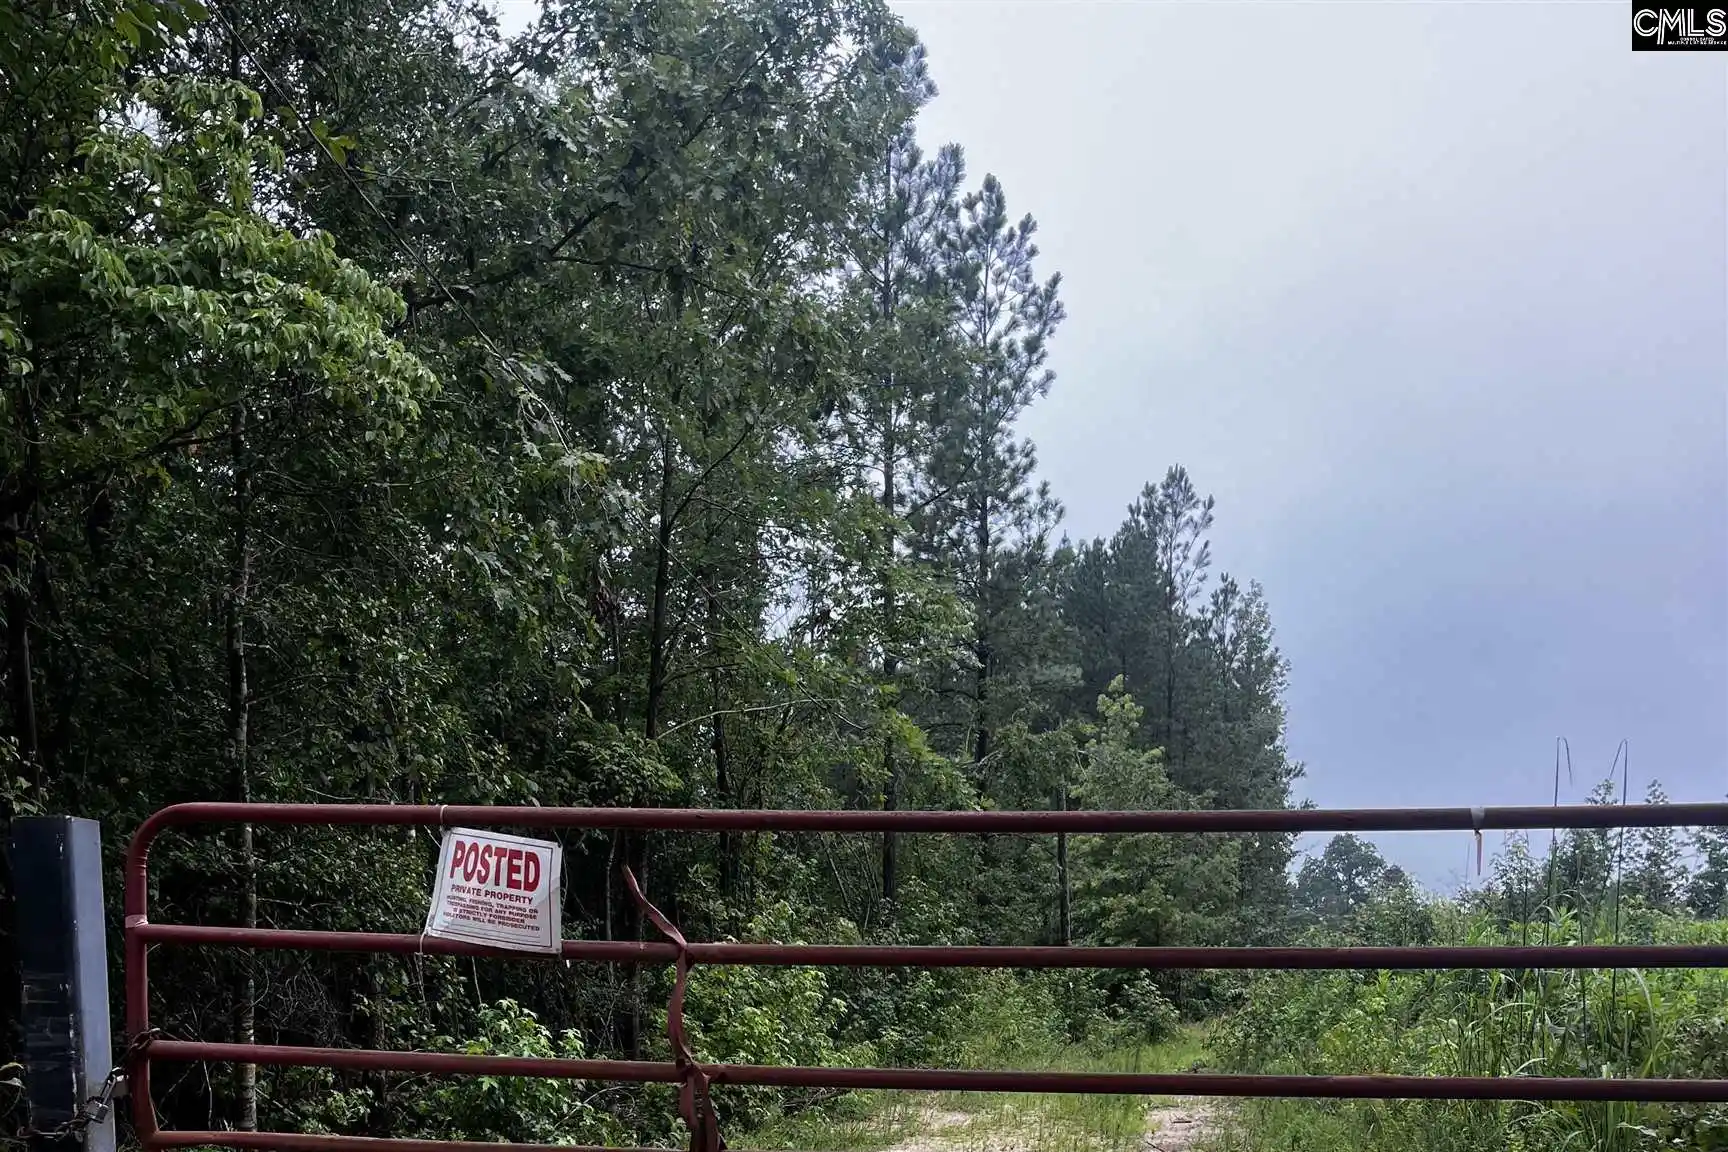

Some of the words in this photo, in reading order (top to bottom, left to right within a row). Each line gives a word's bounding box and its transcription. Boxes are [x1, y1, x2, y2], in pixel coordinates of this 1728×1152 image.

[450, 840, 541, 893] POSTED
[451, 884, 482, 896] PRIVATE
[484, 889, 534, 905] PROPERTY
[496, 902, 527, 912] TRAPPING
[459, 908, 487, 917] STRICTLY
[508, 911, 538, 920] PURPOSE
[498, 920, 540, 931] PROSECUTED
